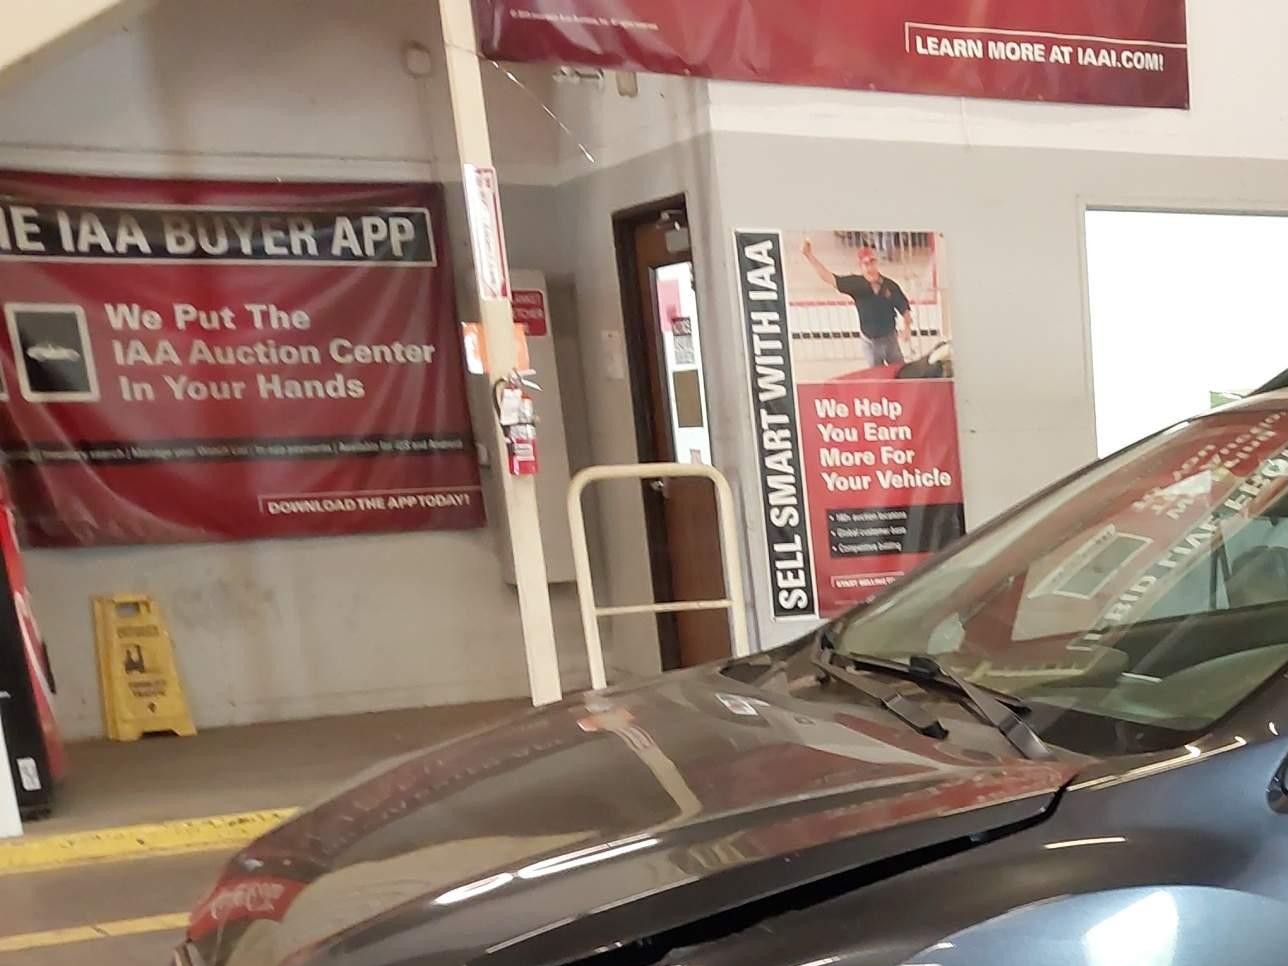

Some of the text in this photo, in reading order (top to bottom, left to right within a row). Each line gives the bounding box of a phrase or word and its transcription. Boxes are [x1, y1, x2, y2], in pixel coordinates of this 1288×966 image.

[916, 35, 1164, 72] LEARN MORE AT IAAI.COM!
[56, 208, 152, 254] IAA
[161, 211, 319, 257] BUYER
[330, 216, 416, 258] APP
[104, 303, 311, 331] We Put The
[111, 337, 436, 367] IAA Auction Center
[118, 373, 365, 401] In Your Hands
[814, 397, 902, 420] We Help
[744, 239, 808, 610] SELL SMART WITH IAA
[817, 421, 912, 442] You Earn
[819, 446, 915, 468] More For
[820, 466, 952, 492] Your Vehicle
[267, 493, 471, 515] DOWNLOAD THE APP TODAY!
